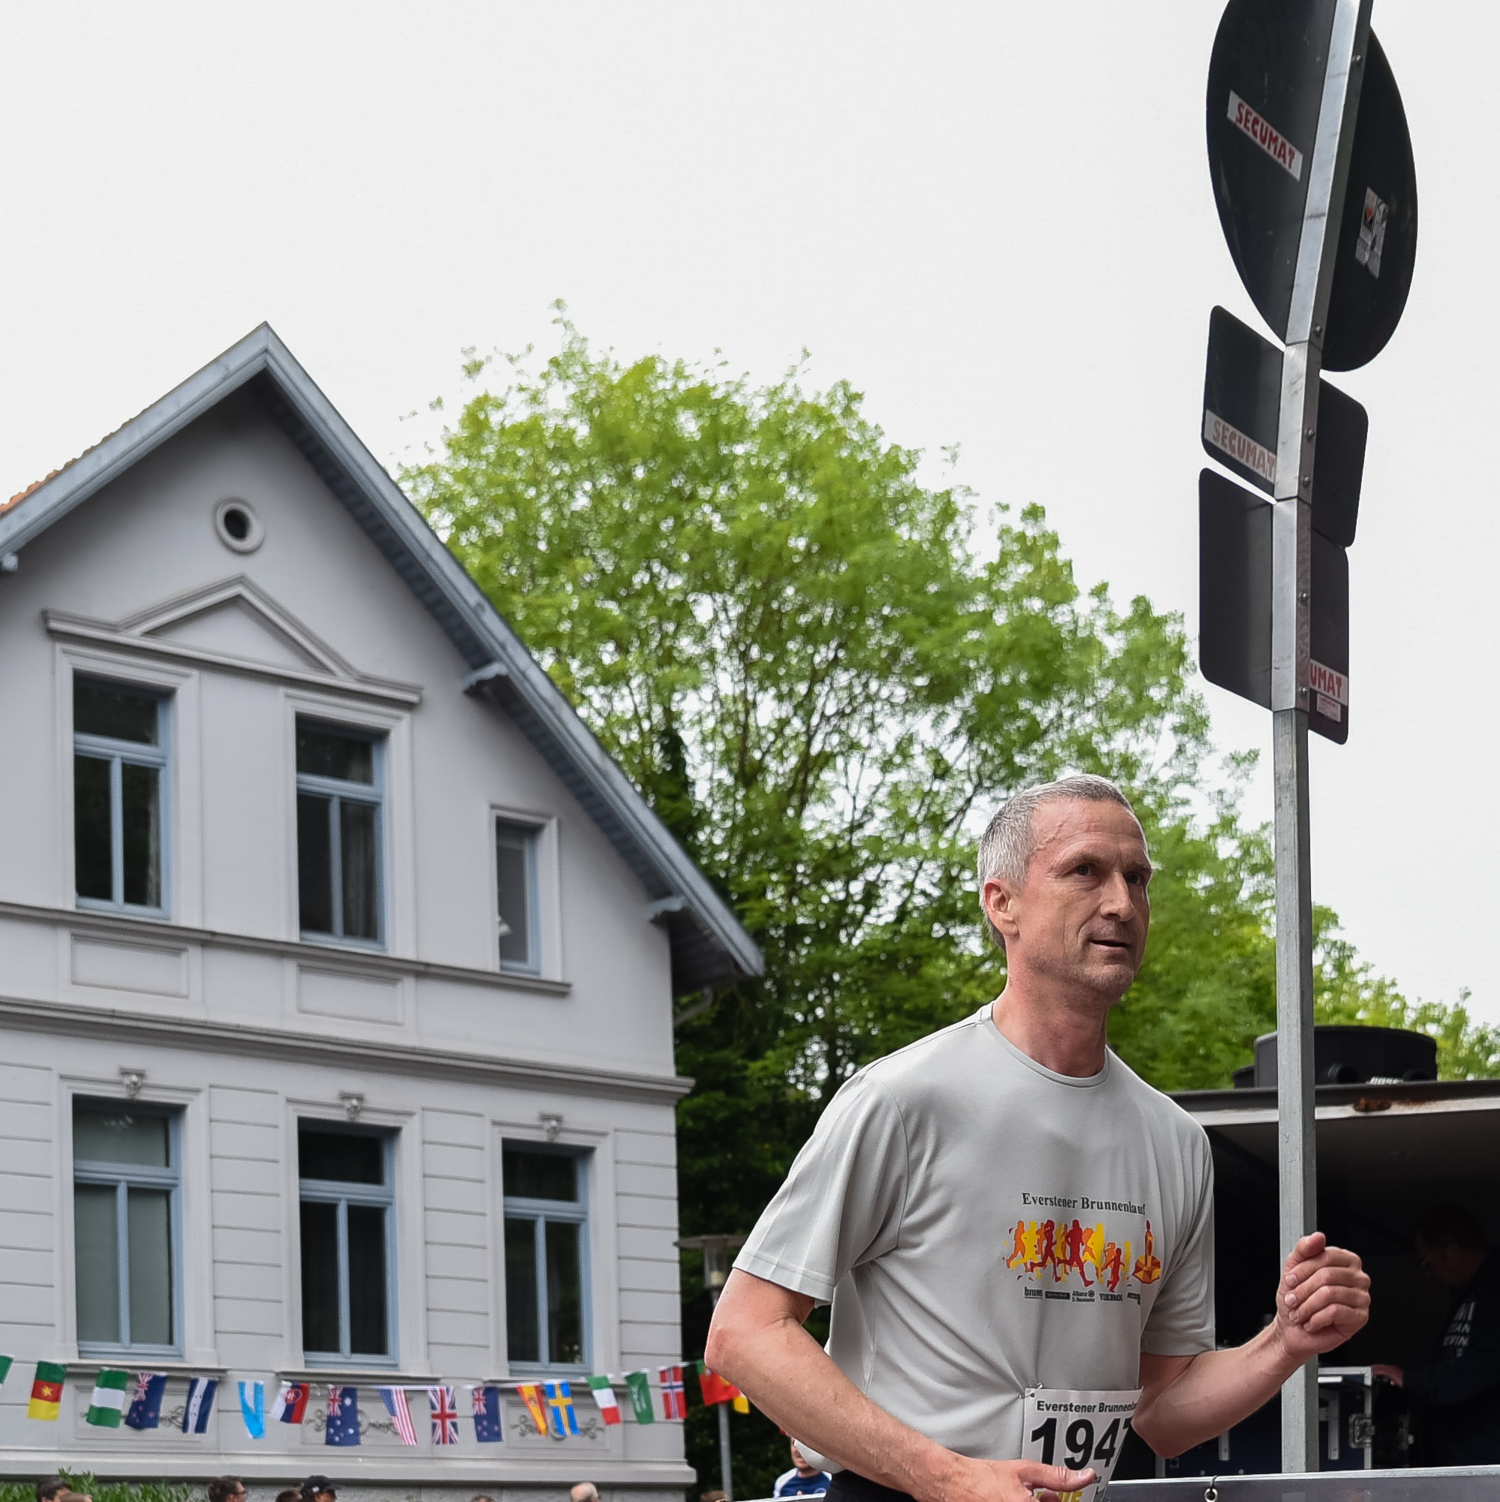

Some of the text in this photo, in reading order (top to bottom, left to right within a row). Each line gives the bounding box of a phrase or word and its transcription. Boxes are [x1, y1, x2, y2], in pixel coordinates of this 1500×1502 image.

[1235, 101, 1296, 170] SECUMAT
[1212, 419, 1276, 480] SECUMAT
[1022, 1193, 1146, 1215] Everstener Brunnenlauf
[1037, 1400, 1097, 1413] Everstener
